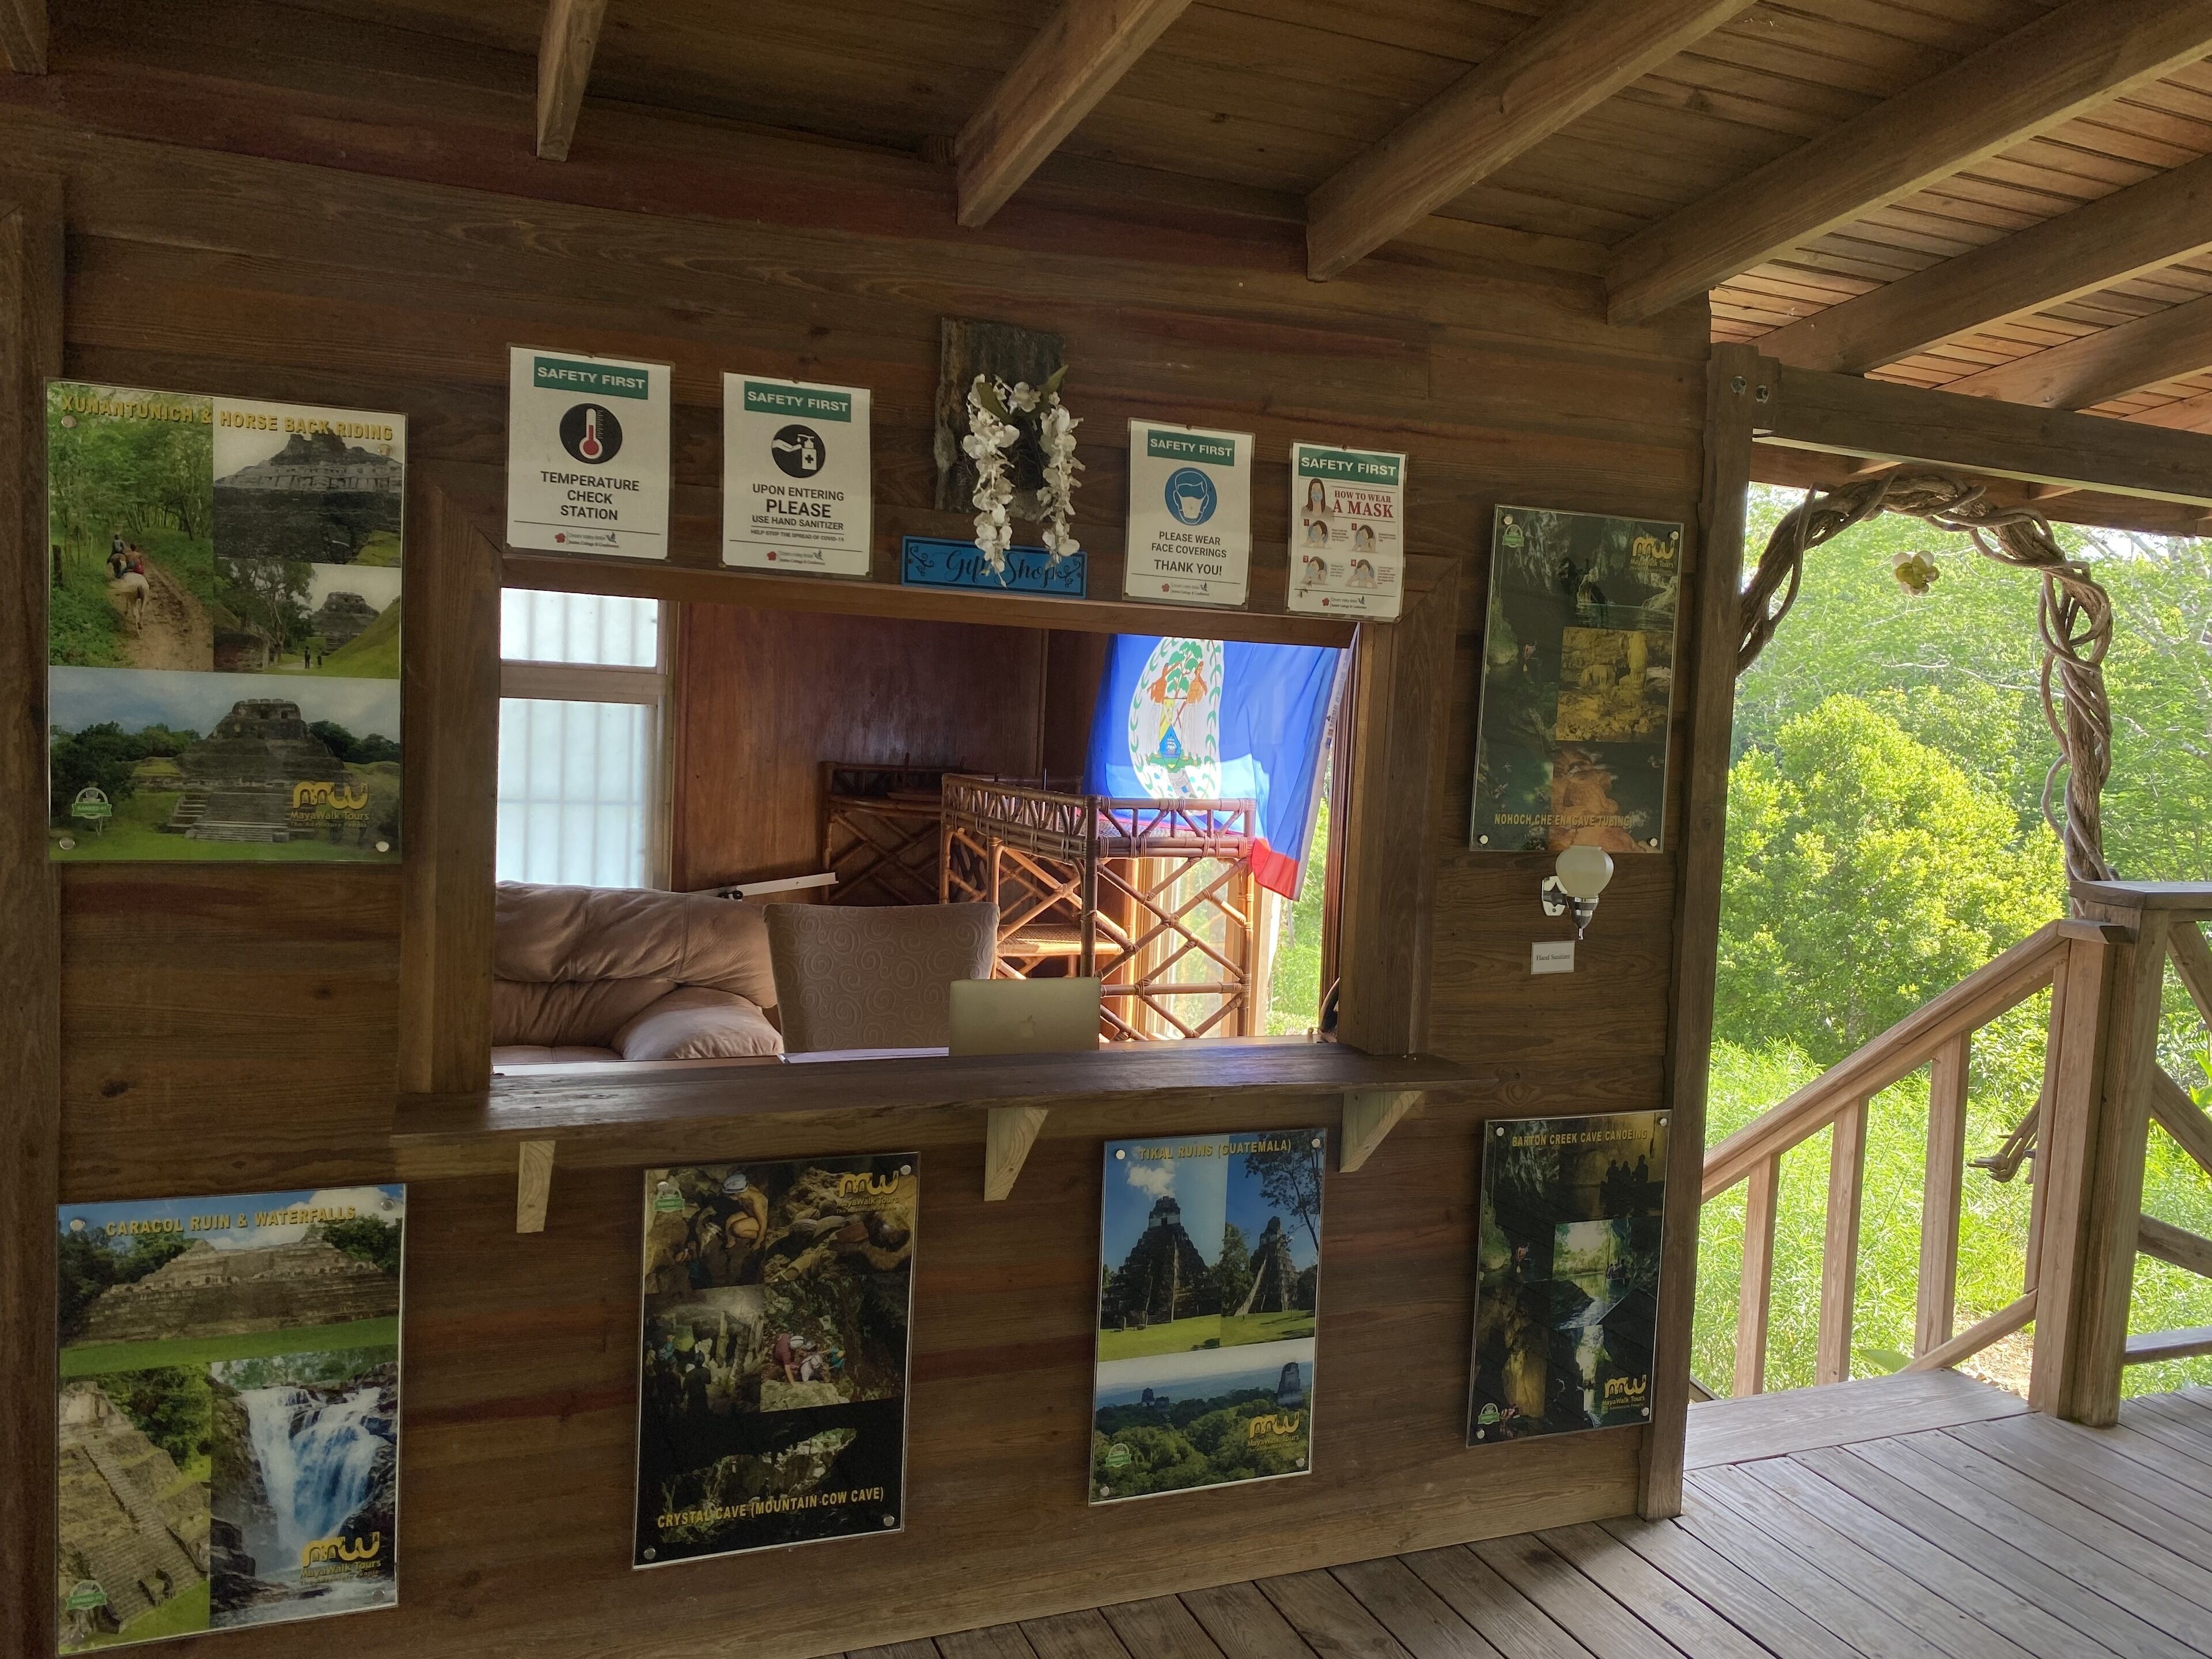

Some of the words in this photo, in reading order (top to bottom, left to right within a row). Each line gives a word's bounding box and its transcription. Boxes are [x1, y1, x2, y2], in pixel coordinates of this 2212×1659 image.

[537, 367, 597, 383] SAFETY
[602, 375, 645, 389] FIRST
[748, 391, 804, 406] SAFETY
[808, 398, 849, 412] FIRST
[62, 395, 194, 423] XUNANTUNICH
[201, 410, 213, 425] &
[220, 410, 278, 431] HORSE
[285, 418, 329, 435] BACK
[336, 422, 393, 440] RIDING
[1150, 438, 1195, 452] SAFETY
[1199, 444, 1232, 457] FIRST
[1301, 457, 1354, 472] SAFETY
[1358, 463, 1396, 476] FIRST
[540, 471, 639, 491] TEMPERATURE
[567, 490, 612, 504] CHECK
[752, 483, 785, 496] UPON
[788, 487, 844, 501] ENTERING
[1335, 490, 1354, 499] HOW
[1355, 493, 1366, 501] TO
[1368, 494, 1391, 503] WEAR
[560, 505, 618, 520] STATION
[766, 498, 831, 518] PLEASE
[1332, 499, 1342, 513] A
[1347, 501, 1393, 518] MASK
[752, 515, 770, 524] USE
[772, 517, 797, 527] HAND
[799, 520, 844, 531] SANITIZER
[1159, 531, 1193, 542] PLEASE
[1195, 535, 1220, 546] WEAR
[1152, 543, 1173, 552] FACE
[1176, 545, 1226, 558] COVERINGS
[995, 552, 1056, 588] Shop
[1154, 559, 1194, 573] THANK
[1196, 563, 1222, 576] YOU!
[290, 810, 340, 822] MayaWalk
[343, 811, 369, 820] Tours
[1494, 813, 1531, 826] NOHOCH
[1569, 815, 1595, 828] (CAVE
[1597, 816, 1633, 828] TUBING)
[1512, 1135, 1546, 1147] BARTON
[1550, 1132, 1577, 1145] CREEK
[1581, 1131, 1602, 1142] CAVE
[1605, 1129, 1647, 1141] CANOEING
[1139, 1146, 1173, 1160] TIKAL
[1178, 1145, 1213, 1158] RUINS
[1218, 1139, 1291, 1158] (GUATEMALA)
[878, 1196, 899, 1205] Tours
[106, 1217, 184, 1236] CARACOL
[190, 1214, 231, 1231] RUIN
[237, 1214, 248, 1228] &
[255, 1205, 357, 1226] WATERFALLS
[1282, 1434, 1300, 1442] Tours
[657, 1509, 710, 1528] CRYSTAL
[714, 1505, 747, 1521] CAVE
[751, 1495, 817, 1518] (MOUNTAIN
[822, 1490, 847, 1506] COW
[851, 1486, 884, 1502] CAVE)
[300, 1563, 351, 1578] MayaWalk
[354, 1560, 381, 1569] Tours
